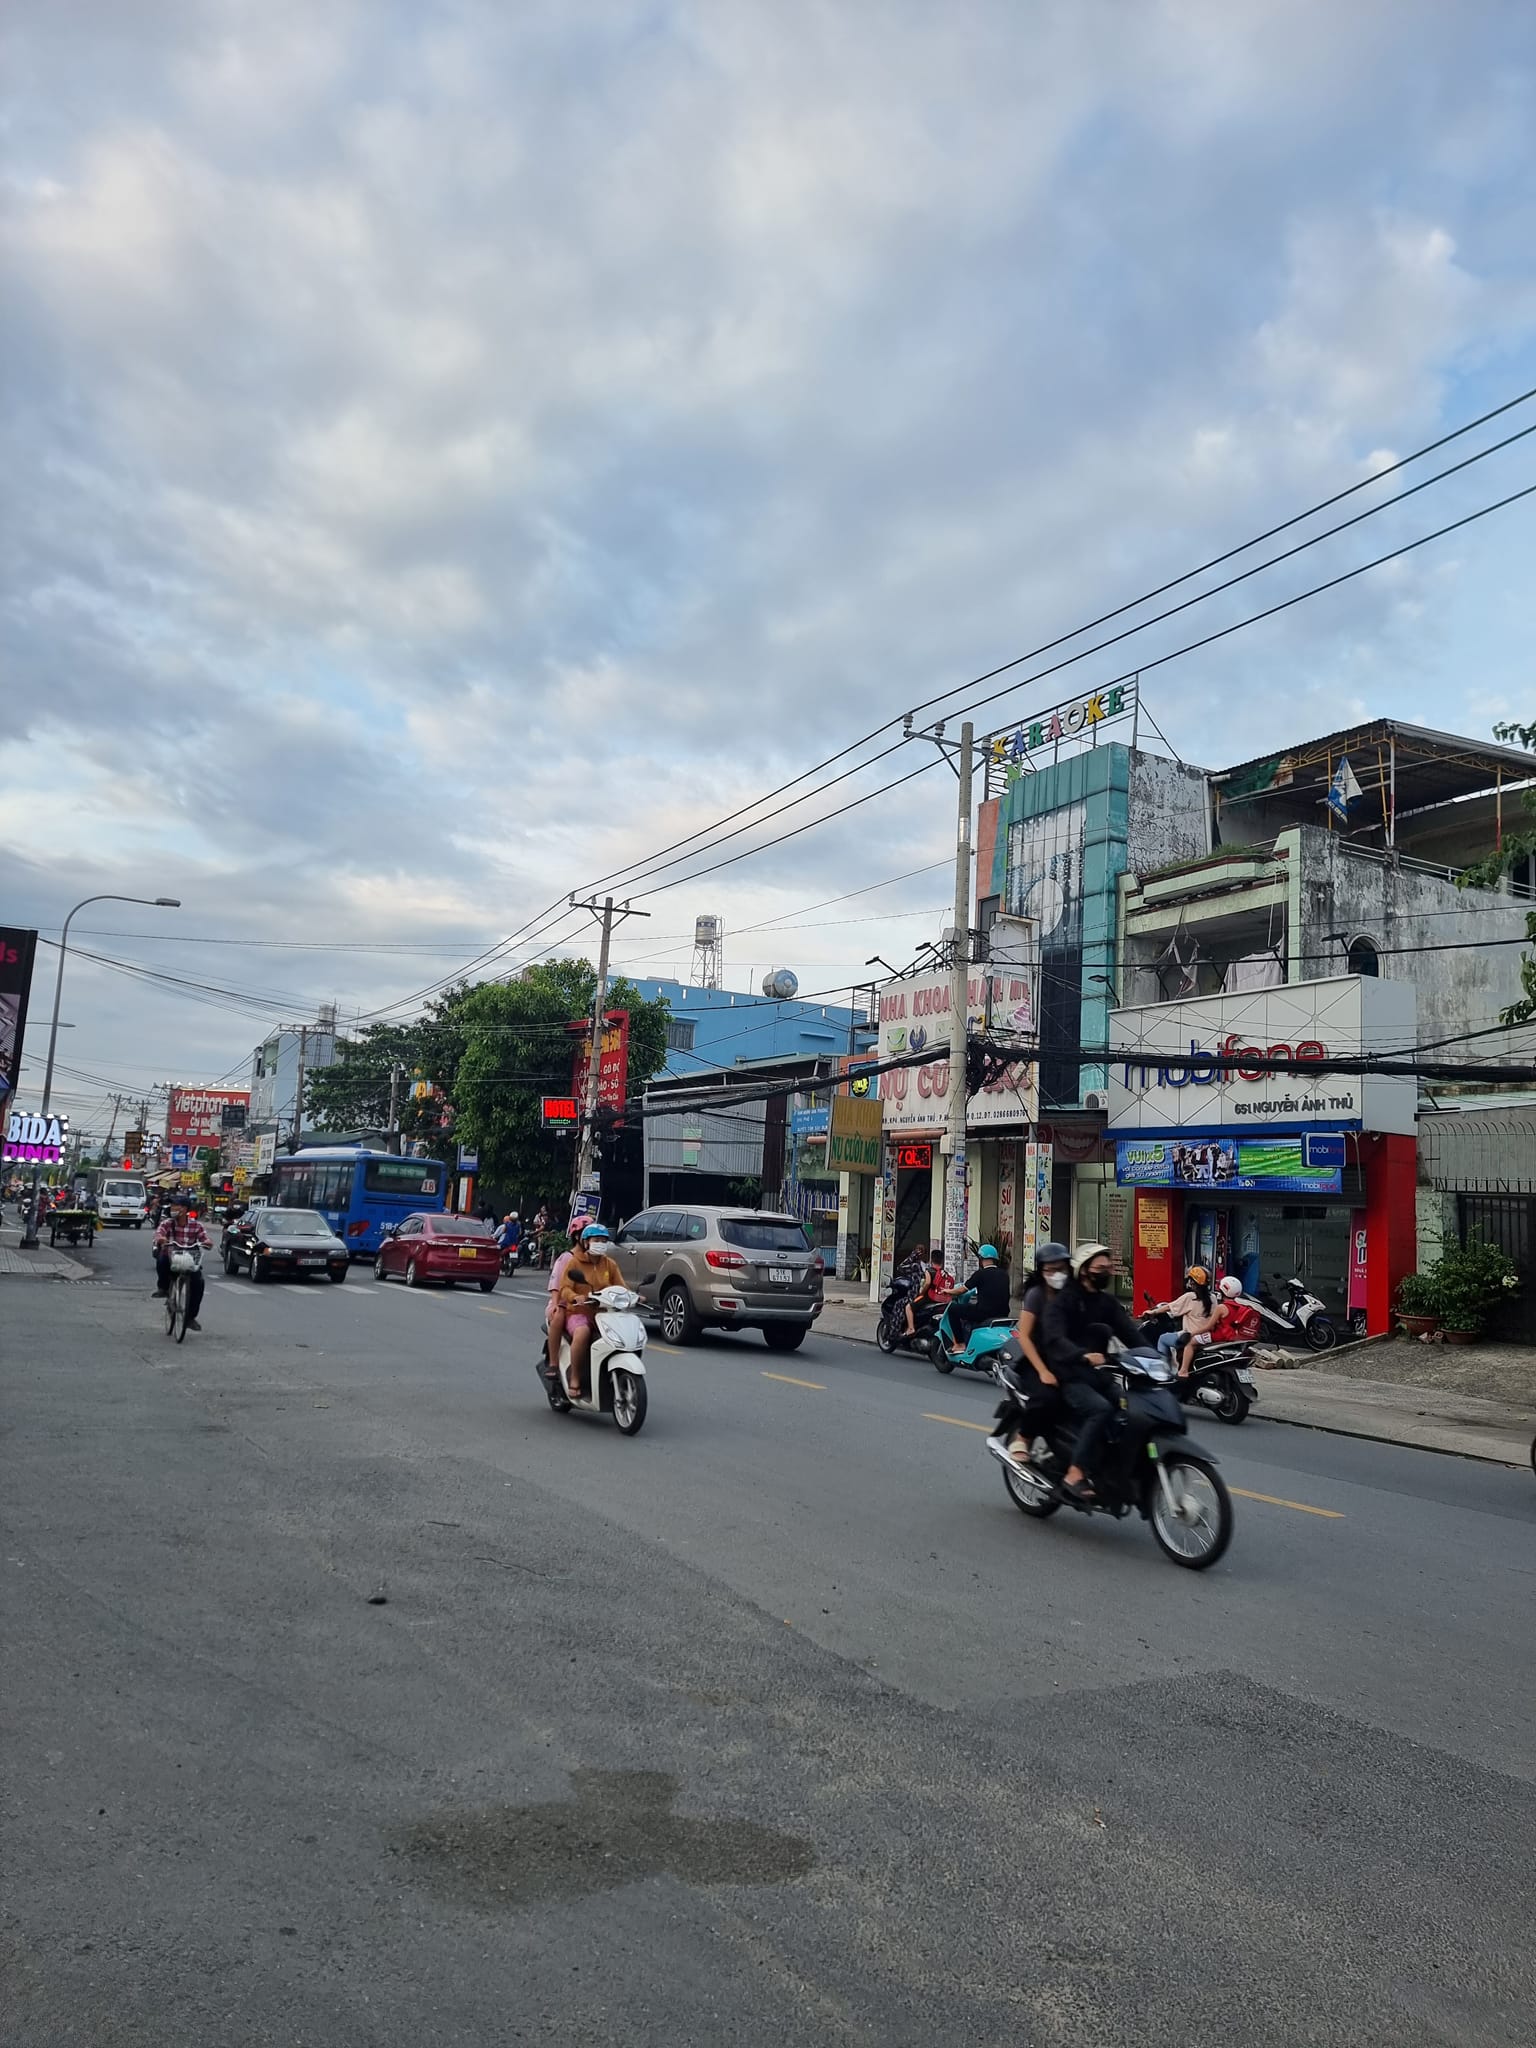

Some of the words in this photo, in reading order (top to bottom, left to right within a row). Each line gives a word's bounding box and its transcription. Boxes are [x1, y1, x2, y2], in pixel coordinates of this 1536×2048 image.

[993, 685, 1125, 764] KARAOKE
[880, 993, 907, 1022] NHA
[912, 985, 951, 1017] KHOA
[1124, 1034, 1328, 1090] mobifone
[544, 1100, 577, 1118] HOTEL
[1235, 1103, 1252, 1115] 651
[1253, 1093, 1298, 1113] NGUYỄN
[1301, 1096, 1326, 1111] ẢNH
[1328, 1092, 1353, 1109] THỦ
[6, 1115, 62, 1146] BIDA
[424, 1180, 434, 1191] 18
